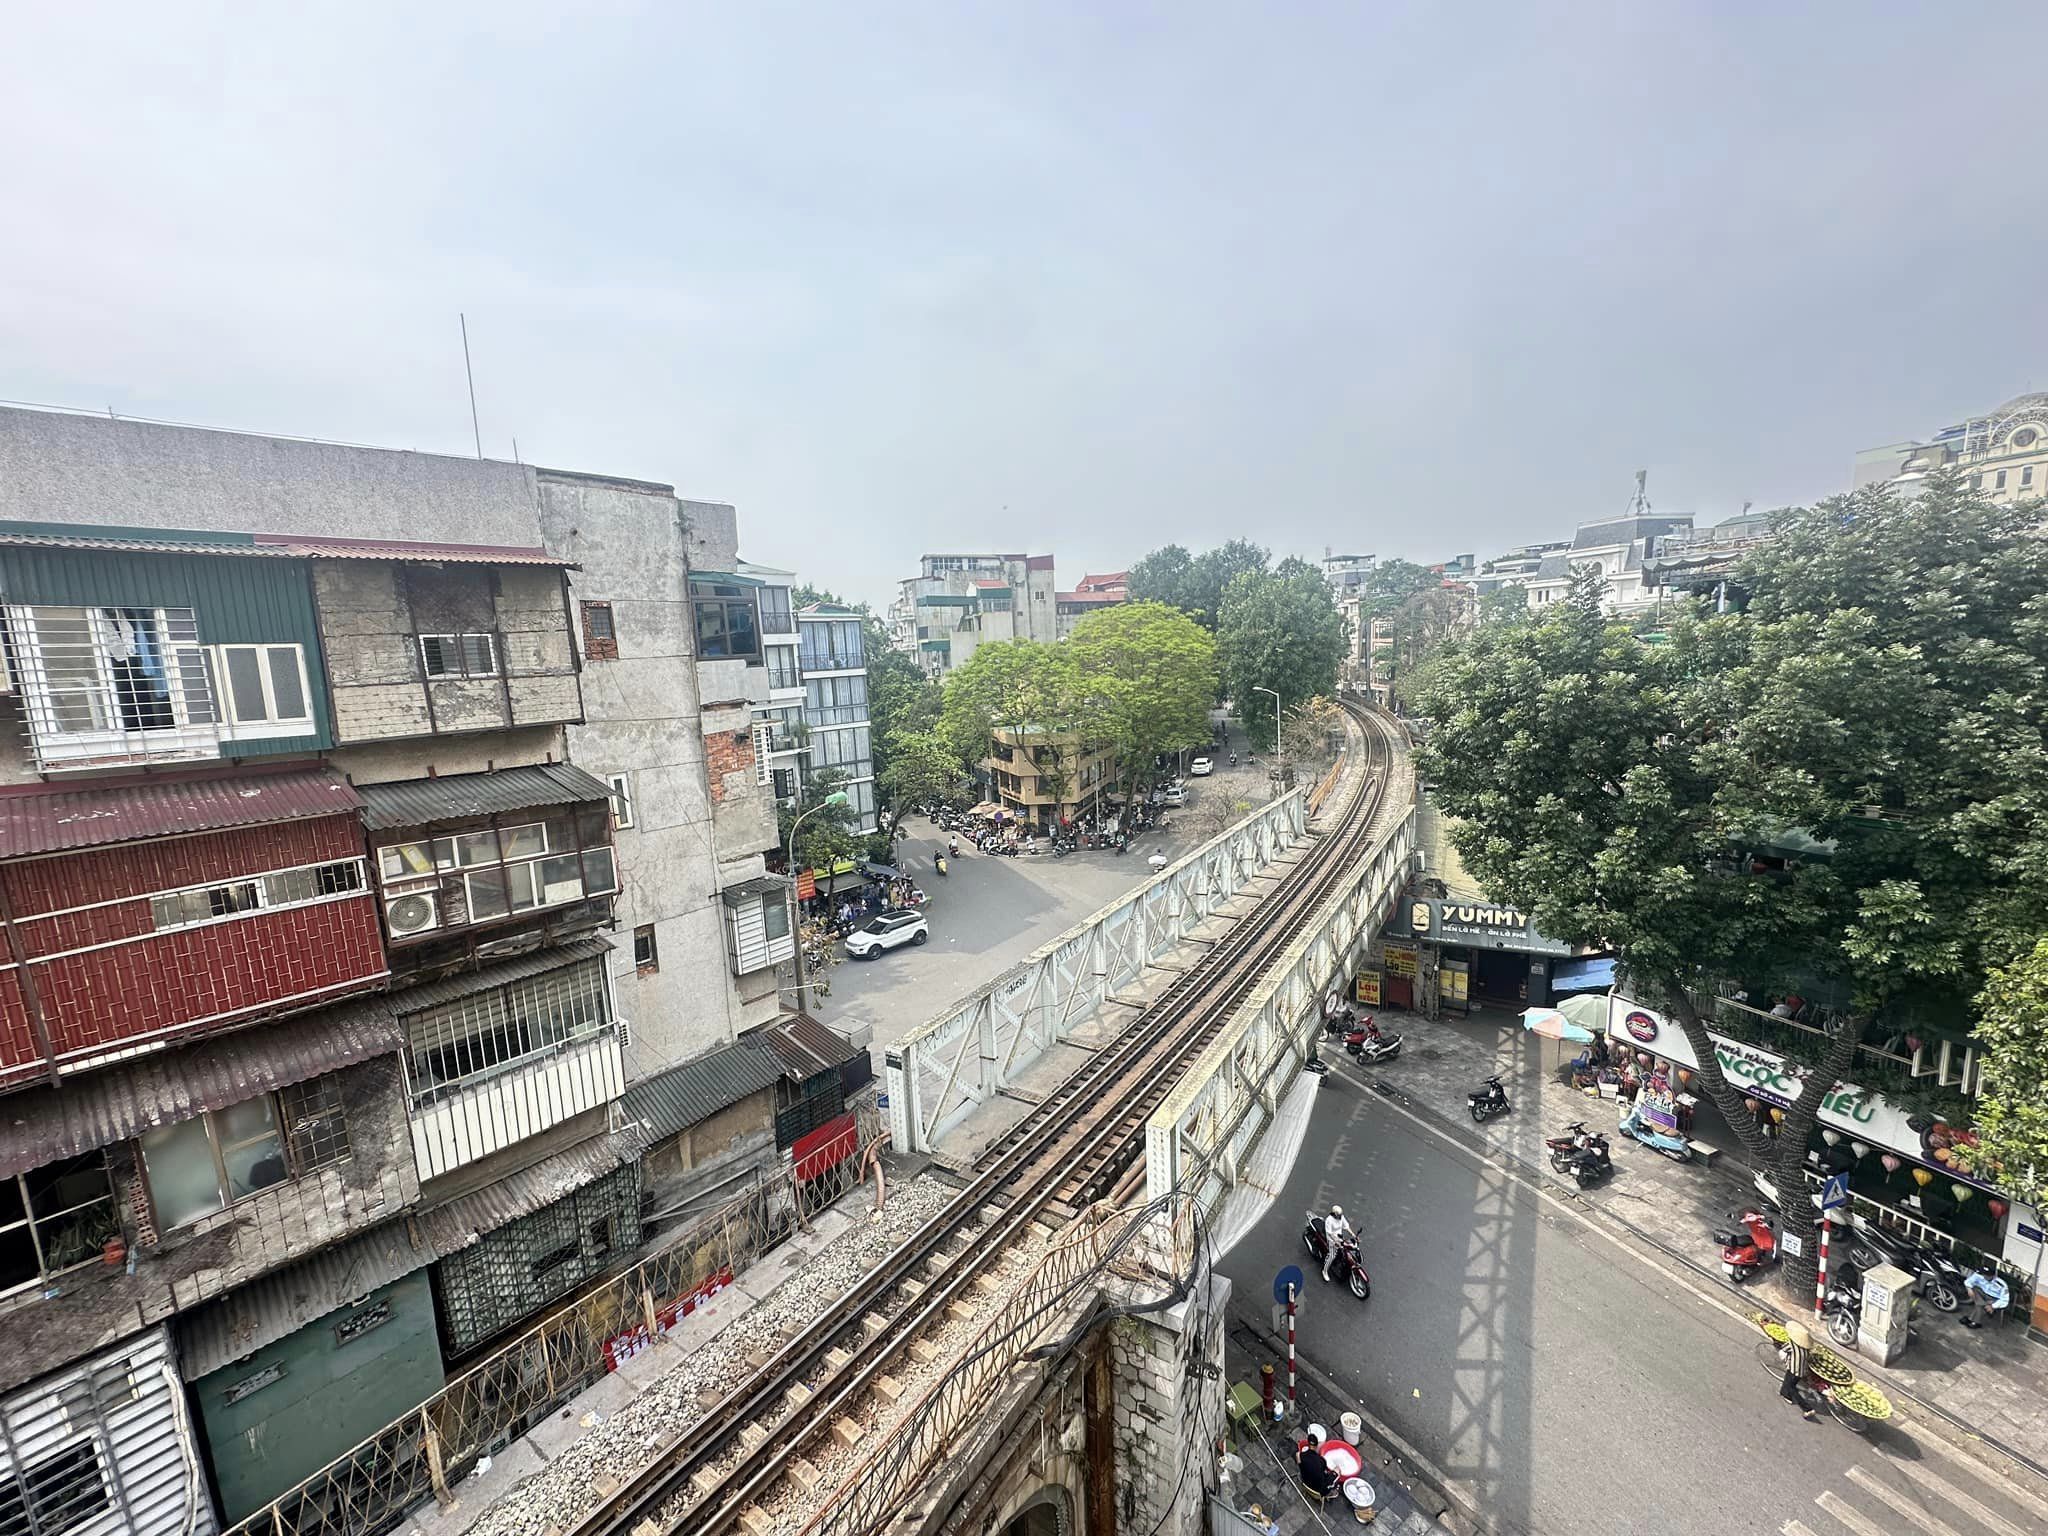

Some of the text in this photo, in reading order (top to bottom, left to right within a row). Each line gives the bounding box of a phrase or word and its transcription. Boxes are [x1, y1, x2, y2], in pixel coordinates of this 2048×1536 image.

[1442, 905, 1528, 928] YUMMY
[1715, 1050, 1793, 1092] NGỌC
[1744, 1053, 1778, 1070] HÀNG
